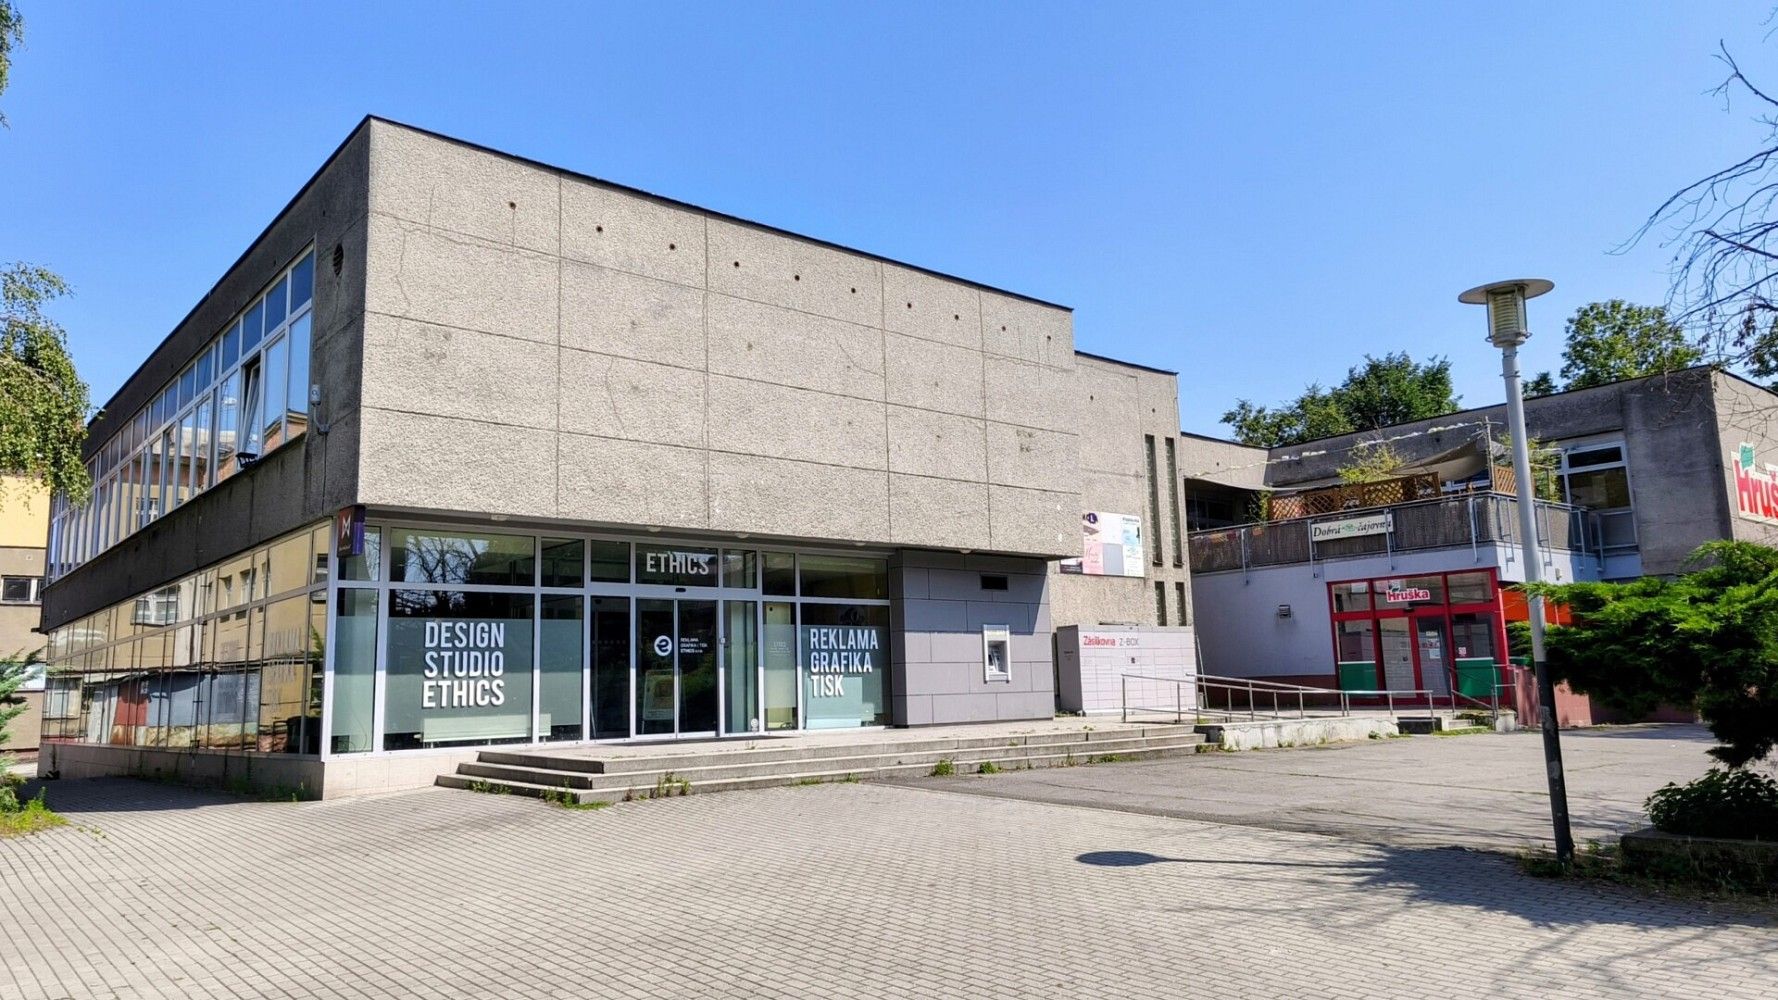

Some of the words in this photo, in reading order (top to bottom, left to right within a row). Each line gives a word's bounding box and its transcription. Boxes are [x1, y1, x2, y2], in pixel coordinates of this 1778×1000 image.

[1313, 526, 1341, 537] Dobrá
[646, 552, 709, 575] ETHICS
[1387, 588, 1429, 601] Hruška
[425, 621, 505, 648] DESIGN
[809, 628, 879, 650] REKLAMA
[424, 651, 504, 678] STUDIO
[810, 651, 873, 674] GRAFIKA
[422, 680, 505, 708] ETHICS
[811, 674, 844, 697] TISK
